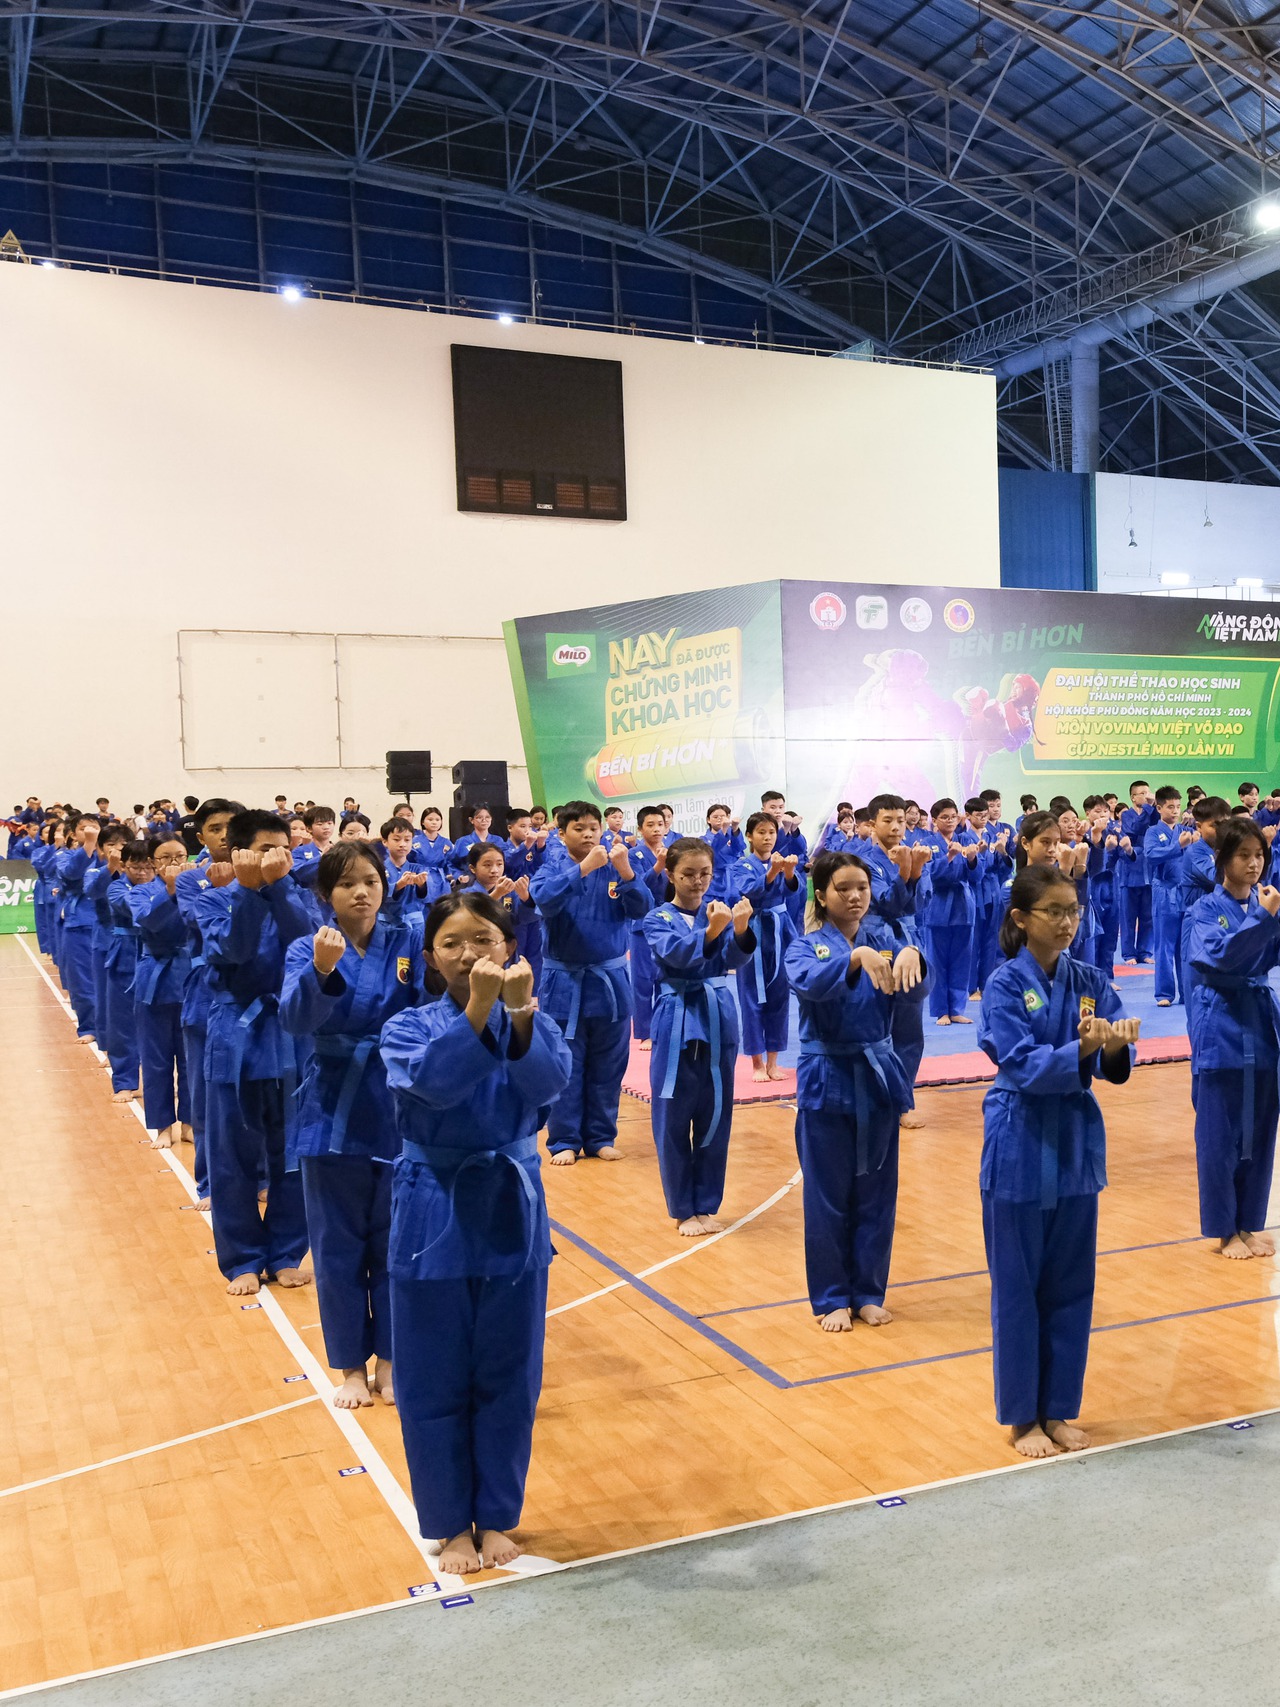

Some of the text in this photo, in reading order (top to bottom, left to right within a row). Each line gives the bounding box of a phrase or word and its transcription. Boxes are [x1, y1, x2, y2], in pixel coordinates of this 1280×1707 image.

[1196, 611, 1247, 633] NĂNG
[1204, 623, 1241, 642] VIỆT
[1242, 628, 1278, 642] NAM
[947, 622, 1085, 659] BỀN BỈ HƠN
[559, 650, 587, 660] MILO
[608, 627, 730, 679] NAY ĐÃ ĐƯỢC
[610, 660, 732, 706] CHỨNG MINH
[1055, 671, 1241, 692] ĐẠI HỘI THỂ THAO HỌC SINH
[1089, 689, 1212, 702] THÀNH PHỐ HỒ CHÍ MINH
[611, 685, 732, 736] KHOA HỌC
[1045, 703, 1064, 718] HỘI
[1065, 703, 1095, 715] KHỎE
[1097, 704, 1119, 715] PHÙ
[1120, 703, 1149, 716] ĐỔNG
[1150, 705, 1173, 716] NĂM
[1175, 707, 1196, 719] HỌC
[1197, 707, 1222, 716] 2023
[1228, 708, 1252, 717] 2024
[1056, 718, 1091, 735] MÔN
[1092, 721, 1160, 735] VOVINAM
[1161, 719, 1192, 739] VIỆT
[1214, 722, 1244, 739] ĐẠO
[1067, 738, 1235, 756] CÚP NESTLÉ MILO LẦN VII
[599, 753, 634, 778] BỀN
[636, 744, 660, 771] BỈ
[686, 796, 706, 813] lâm
